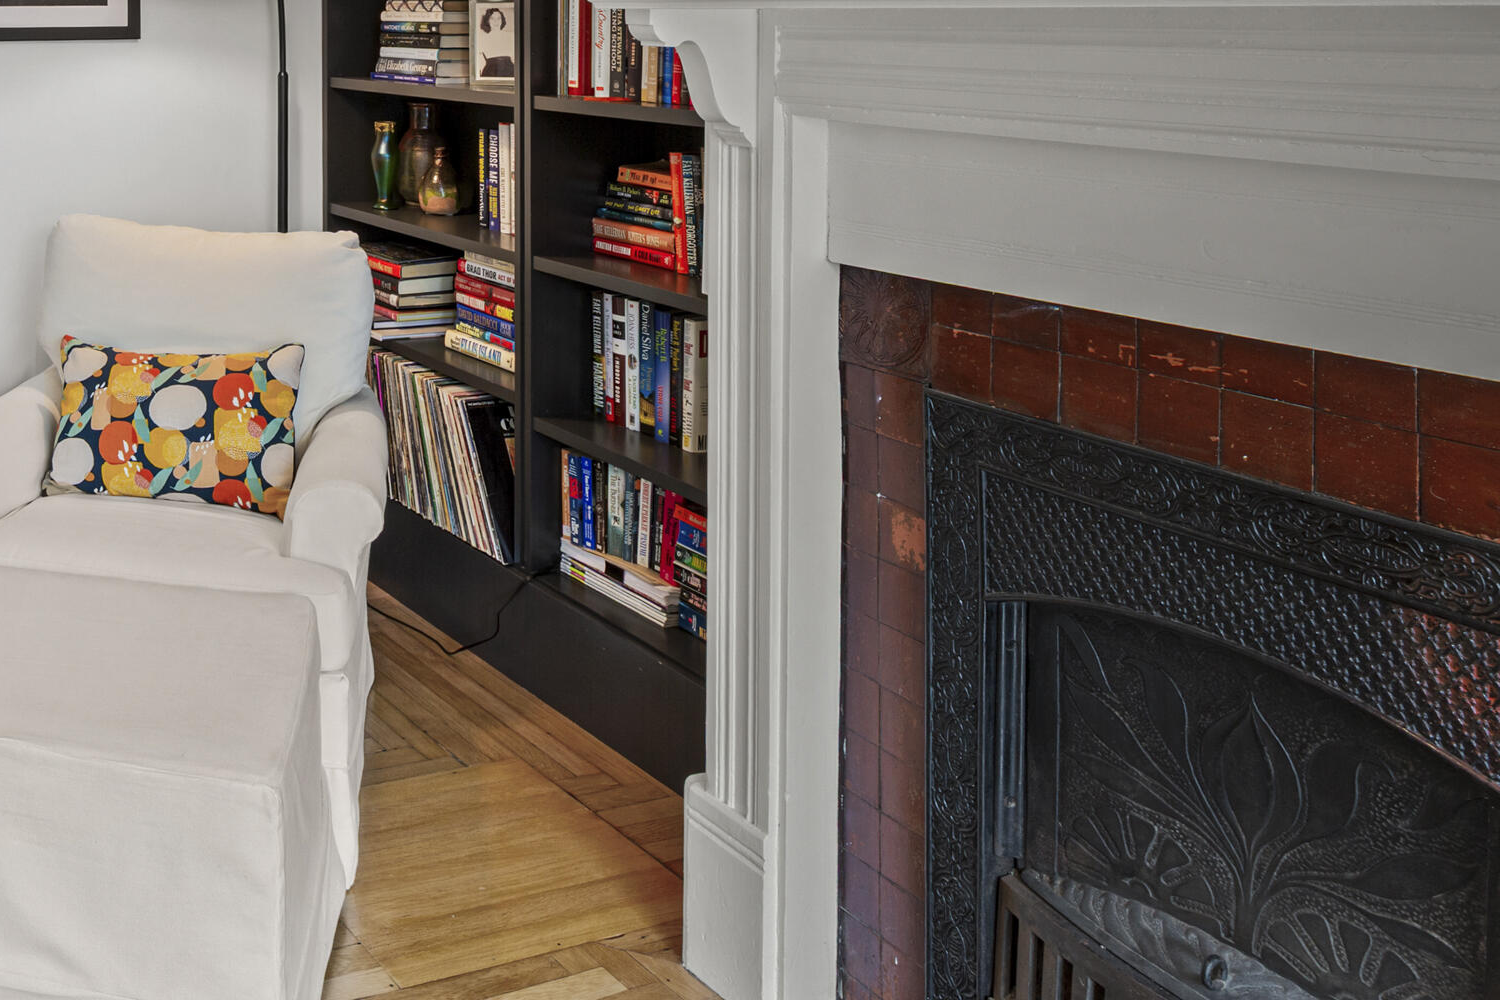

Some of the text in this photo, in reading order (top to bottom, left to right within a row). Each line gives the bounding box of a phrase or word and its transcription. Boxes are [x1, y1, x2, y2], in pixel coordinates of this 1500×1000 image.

[466, 263, 497, 280] BRAD THOR
[641, 303, 652, 360] Daniel Silva
